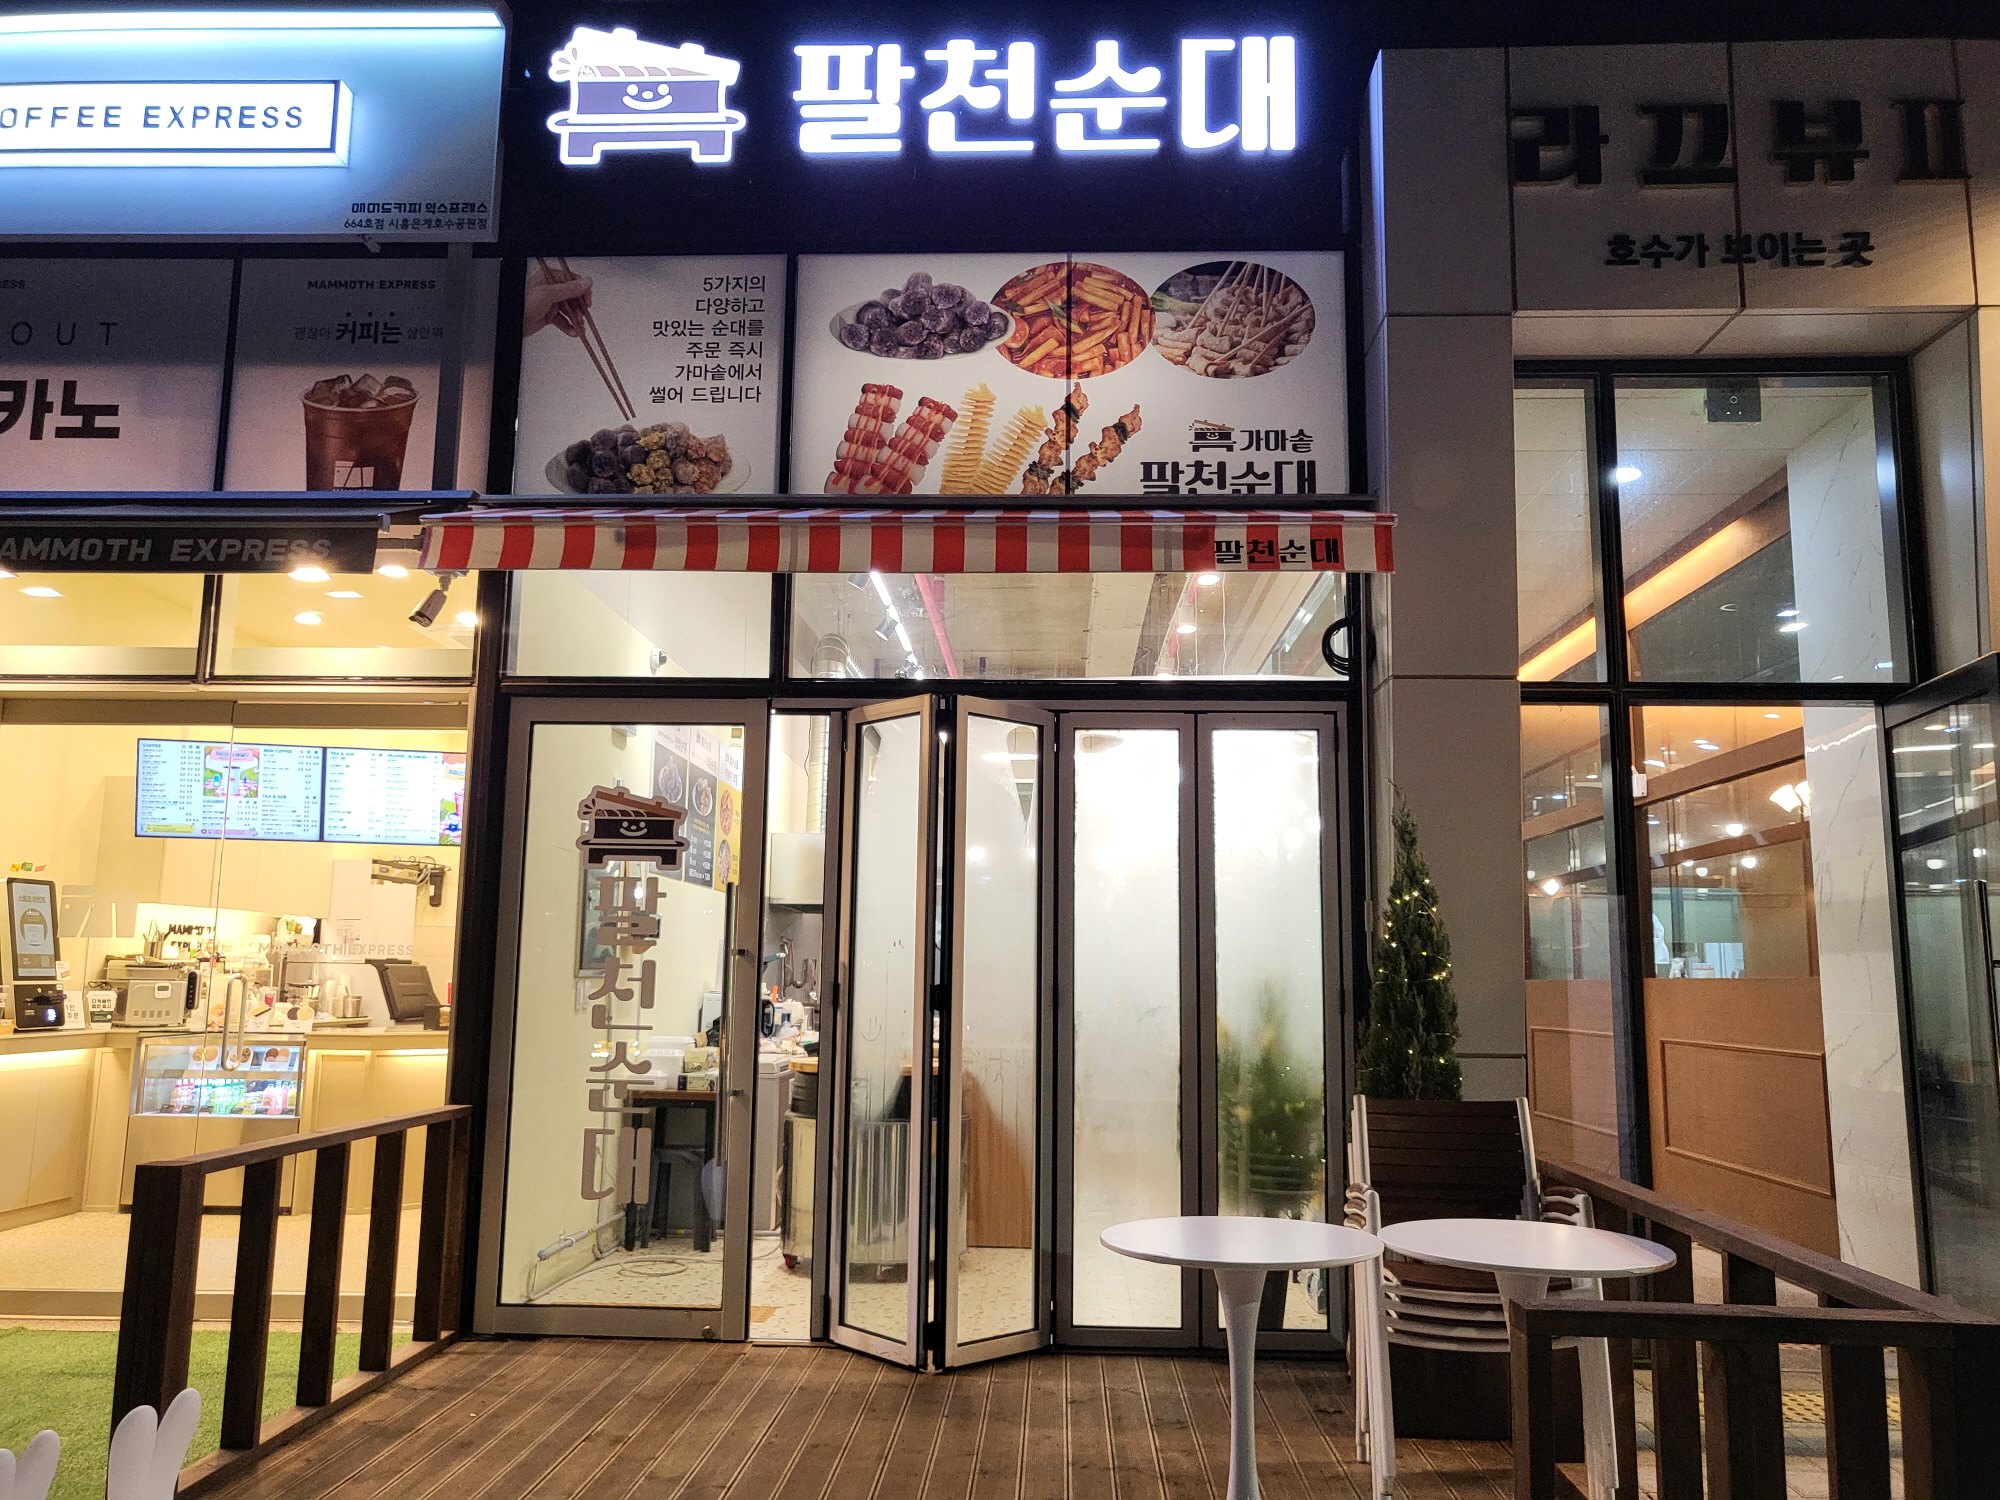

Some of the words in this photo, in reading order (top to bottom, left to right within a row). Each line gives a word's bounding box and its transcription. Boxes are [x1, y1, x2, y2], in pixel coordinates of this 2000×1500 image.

[791, 34, 1298, 154] 팔천순대
[0, 105, 122, 129] OFFEE
[143, 105, 304, 129] EXPRESS
[344, 218, 385, 229] 664호점
[1605, 232, 1710, 268] 호수가
[1720, 231, 1827, 268] 보이는
[1831, 231, 1876, 268] 곳
[307, 279, 375, 290] MAMMOTH
[379, 279, 436, 290] EXPRESS
[702, 275, 766, 293] 5가지의
[695, 297, 766, 315] 다양하고
[10, 321, 119, 346] OUT
[336, 320, 403, 344] 커피는
[652, 320, 705, 338] 맛있는
[711, 319, 765, 337] 순대를
[685, 342, 722, 359] 주문
[728, 341, 763, 358] 즉시
[675, 363, 762, 381] 가마솥에서
[649, 387, 684, 404] 썰어
[690, 386, 762, 404] 드립니다
[1239, 428, 1314, 454] 가마솥
[1139, 459, 1316, 495] 팔천순대
[0, 536, 152, 563] AMMOTH
[169, 537, 331, 564] EXPRESS
[1213, 538, 1340, 564] 팔천순대
[348, 943, 414, 956] EXPRESS
[580, 875, 667, 1206] 팔천순대
